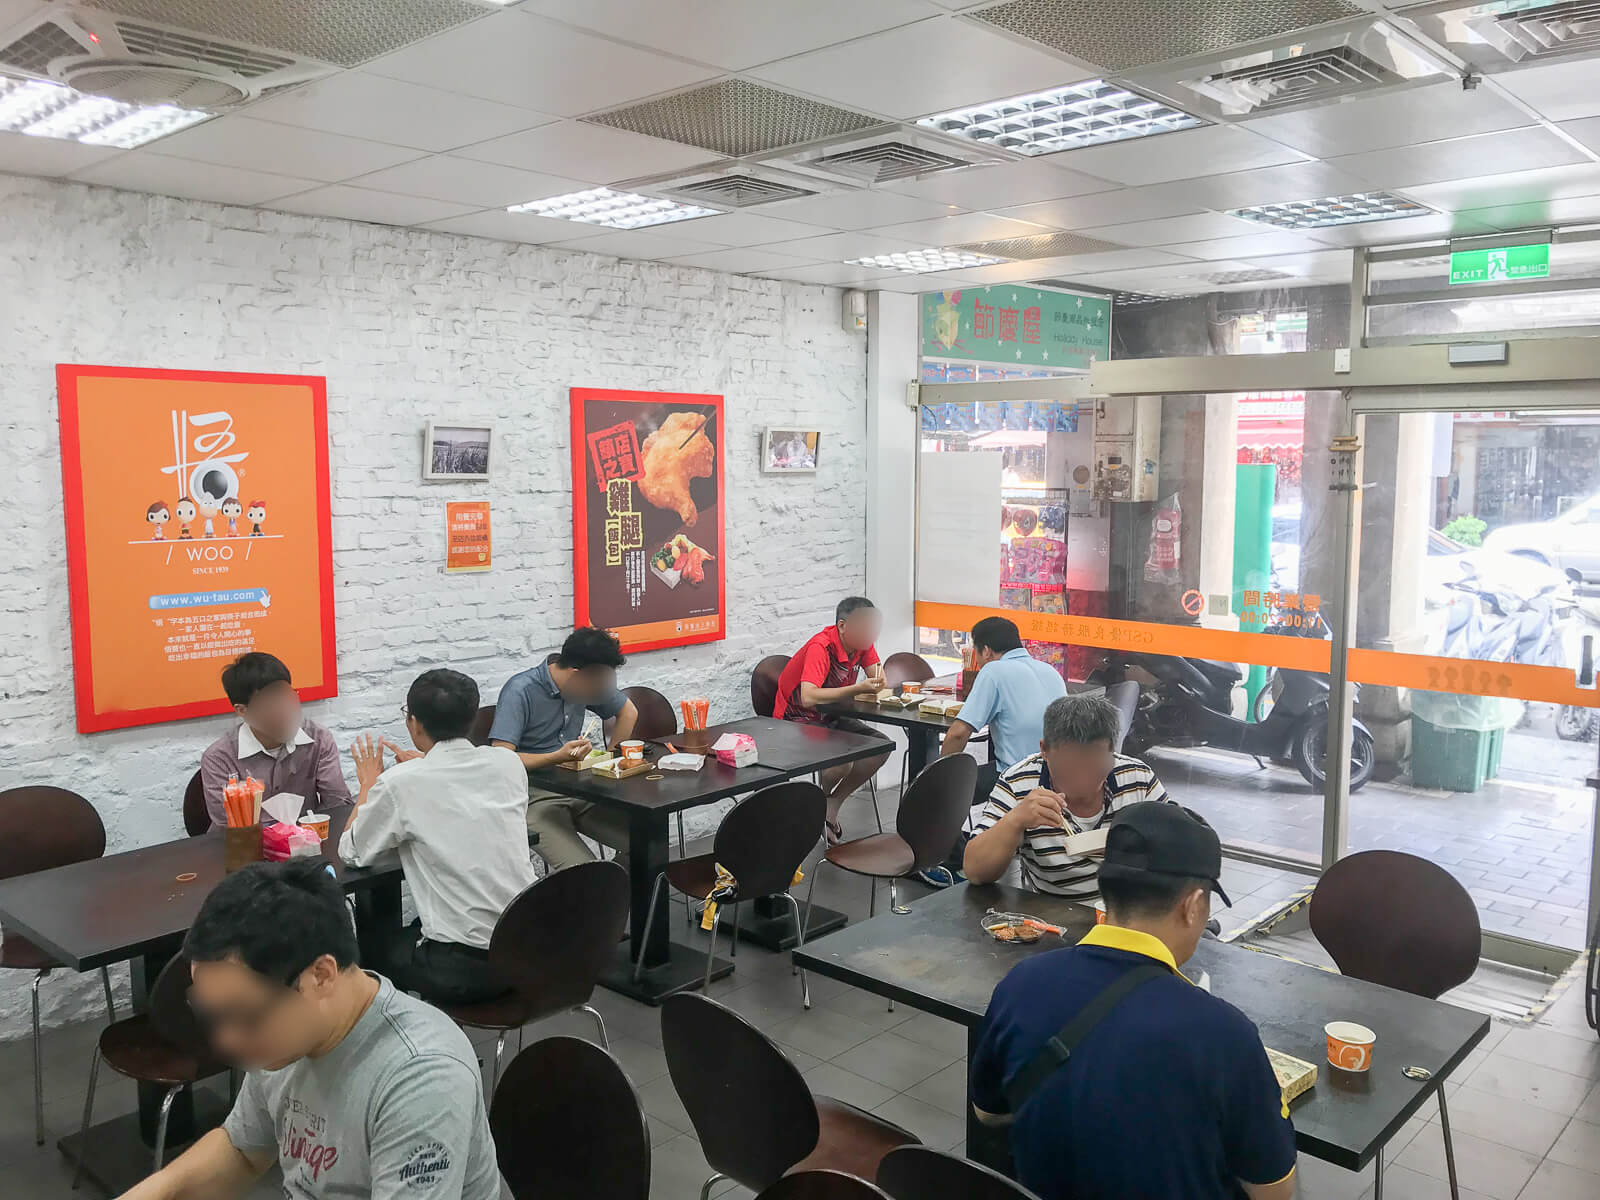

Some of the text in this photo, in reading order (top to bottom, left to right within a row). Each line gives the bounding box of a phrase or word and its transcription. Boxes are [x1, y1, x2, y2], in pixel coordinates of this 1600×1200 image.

[1453, 269, 1484, 280] EXIT
[974, 297, 1041, 345] 節慶屋
[186, 545, 233, 561] WOO
